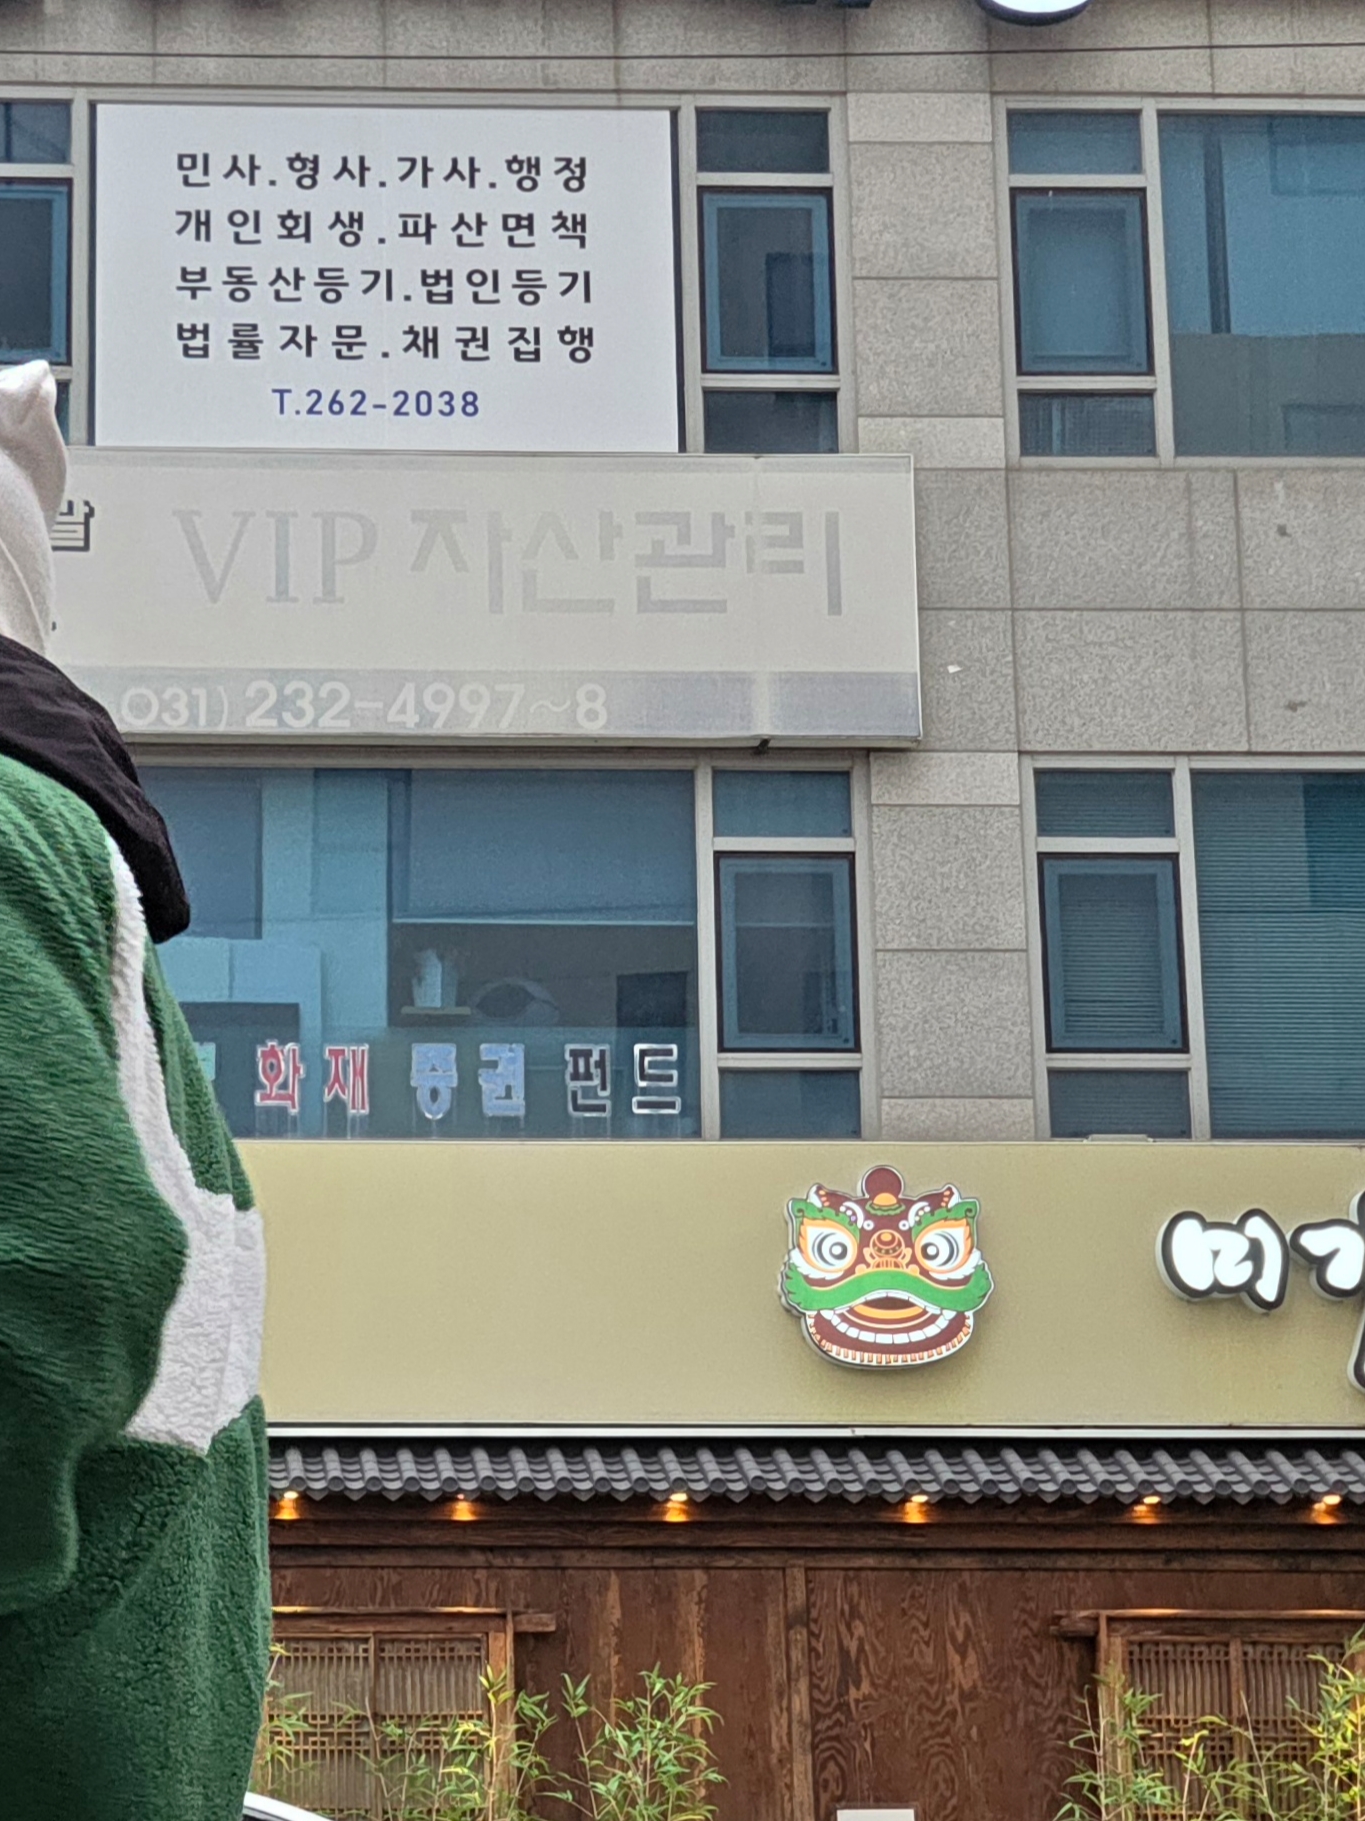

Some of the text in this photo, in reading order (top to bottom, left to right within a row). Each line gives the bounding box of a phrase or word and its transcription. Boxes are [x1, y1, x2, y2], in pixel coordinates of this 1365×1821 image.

[176, 152, 588, 193] 민사.형사.가사.행정
[175, 209, 588, 250] 개인회생.파산면책
[175, 266, 592, 306] 부동산등기.법인등기
[176, 322, 595, 364] 법률자문.채권집행
[271, 388, 480, 418] T.262-2038
[172, 508, 378, 605] VIP
[410, 508, 843, 616] 자산관리
[254, 1038, 369, 1115] 화재
[410, 1042, 527, 1120] 증권
[565, 1042, 682, 1117] 펀드
